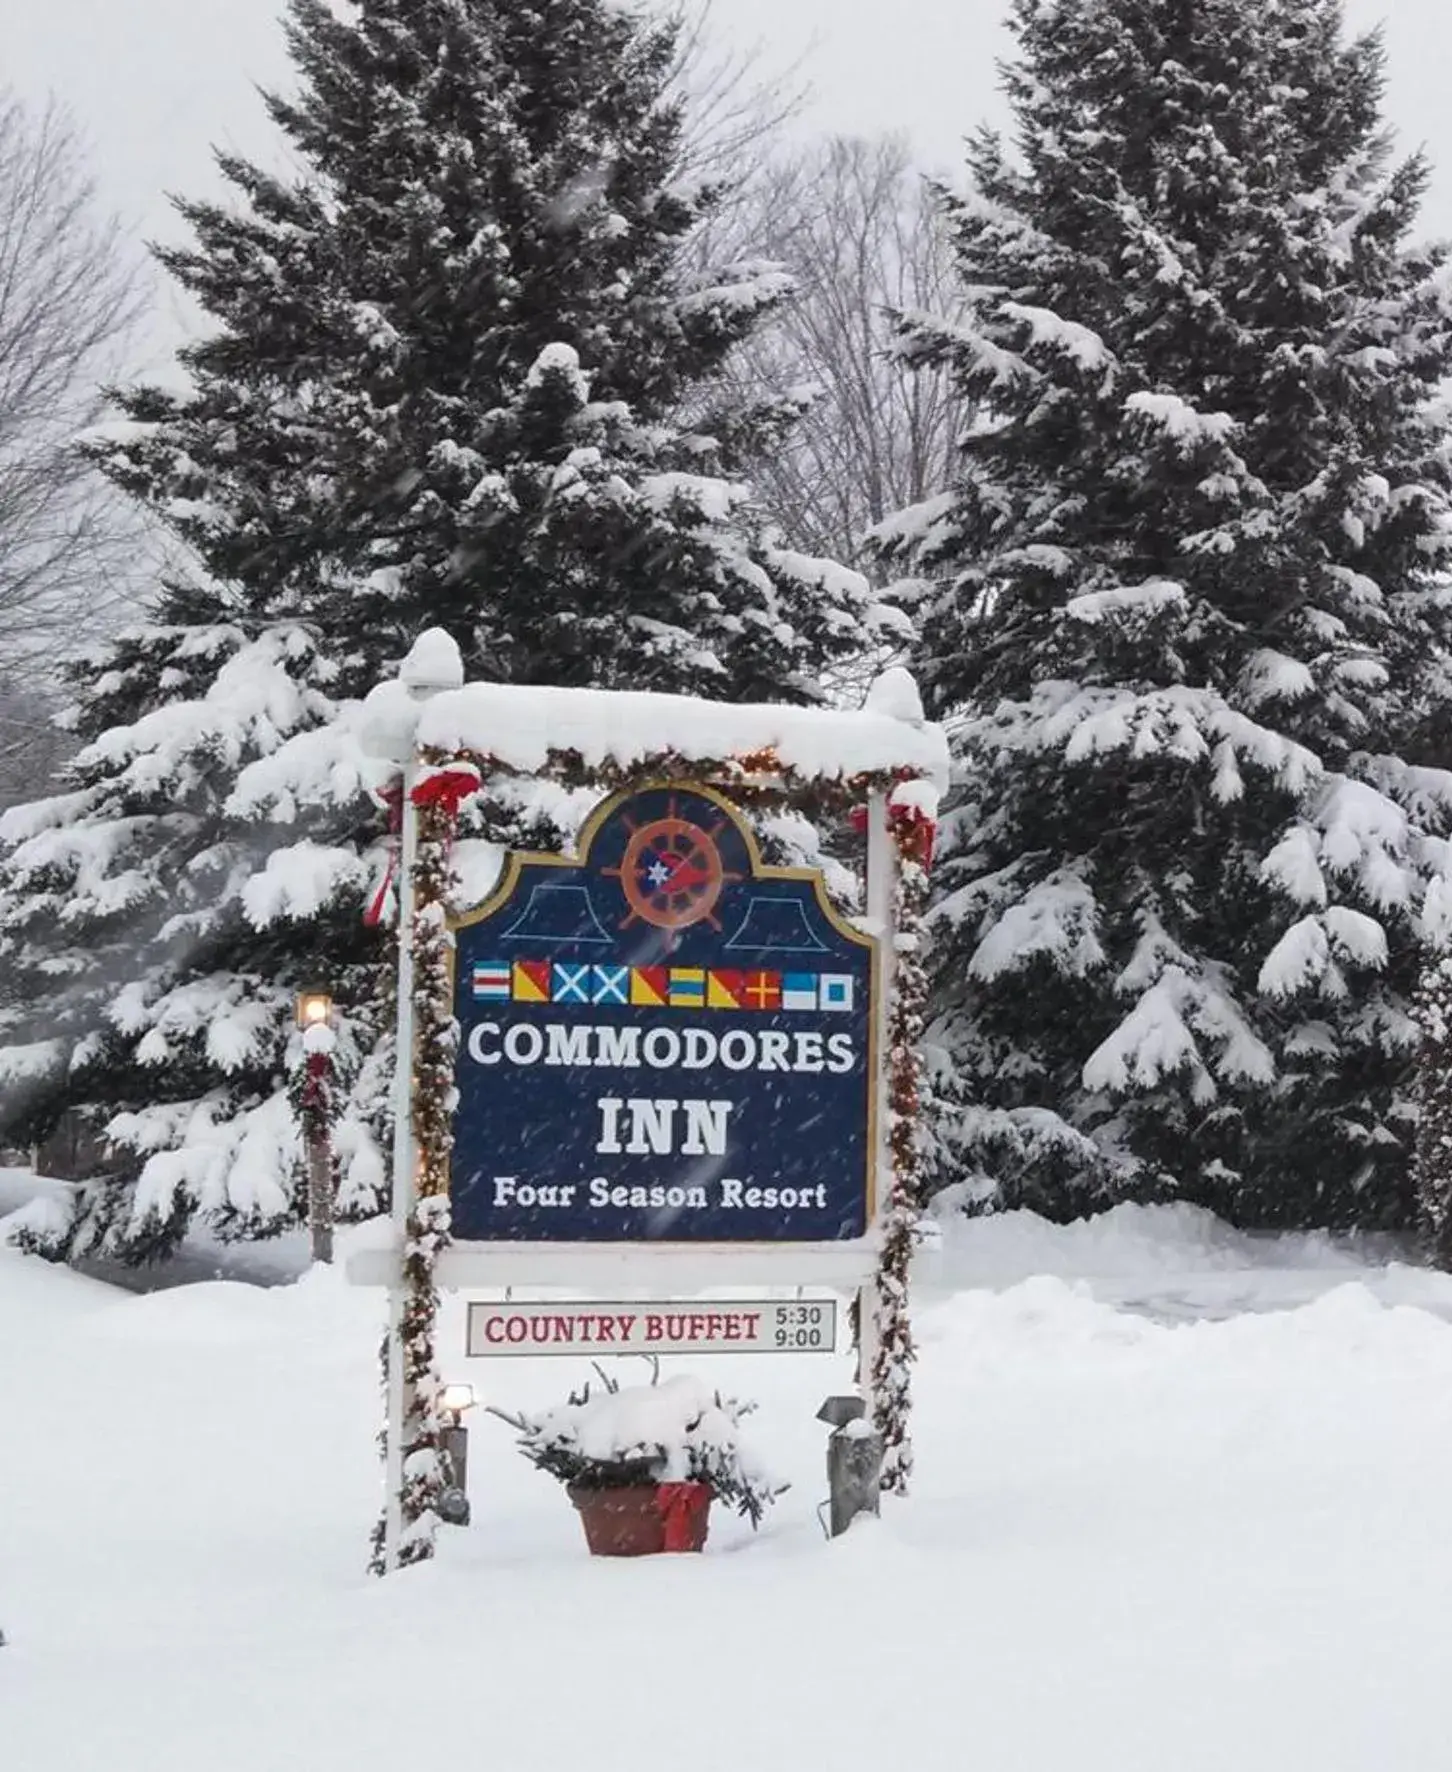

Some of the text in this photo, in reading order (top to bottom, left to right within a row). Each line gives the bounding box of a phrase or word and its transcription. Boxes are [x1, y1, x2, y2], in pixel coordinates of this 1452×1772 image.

[468, 1022, 856, 1073] COMMODORES
[596, 1097, 733, 1156] INN
[493, 1177, 828, 1209] Four Season Resort
[484, 1313, 761, 1343] COUNTRY BUFFET
[775, 1307, 822, 1325] 5:30
[774, 1328, 822, 1347] 9:00
